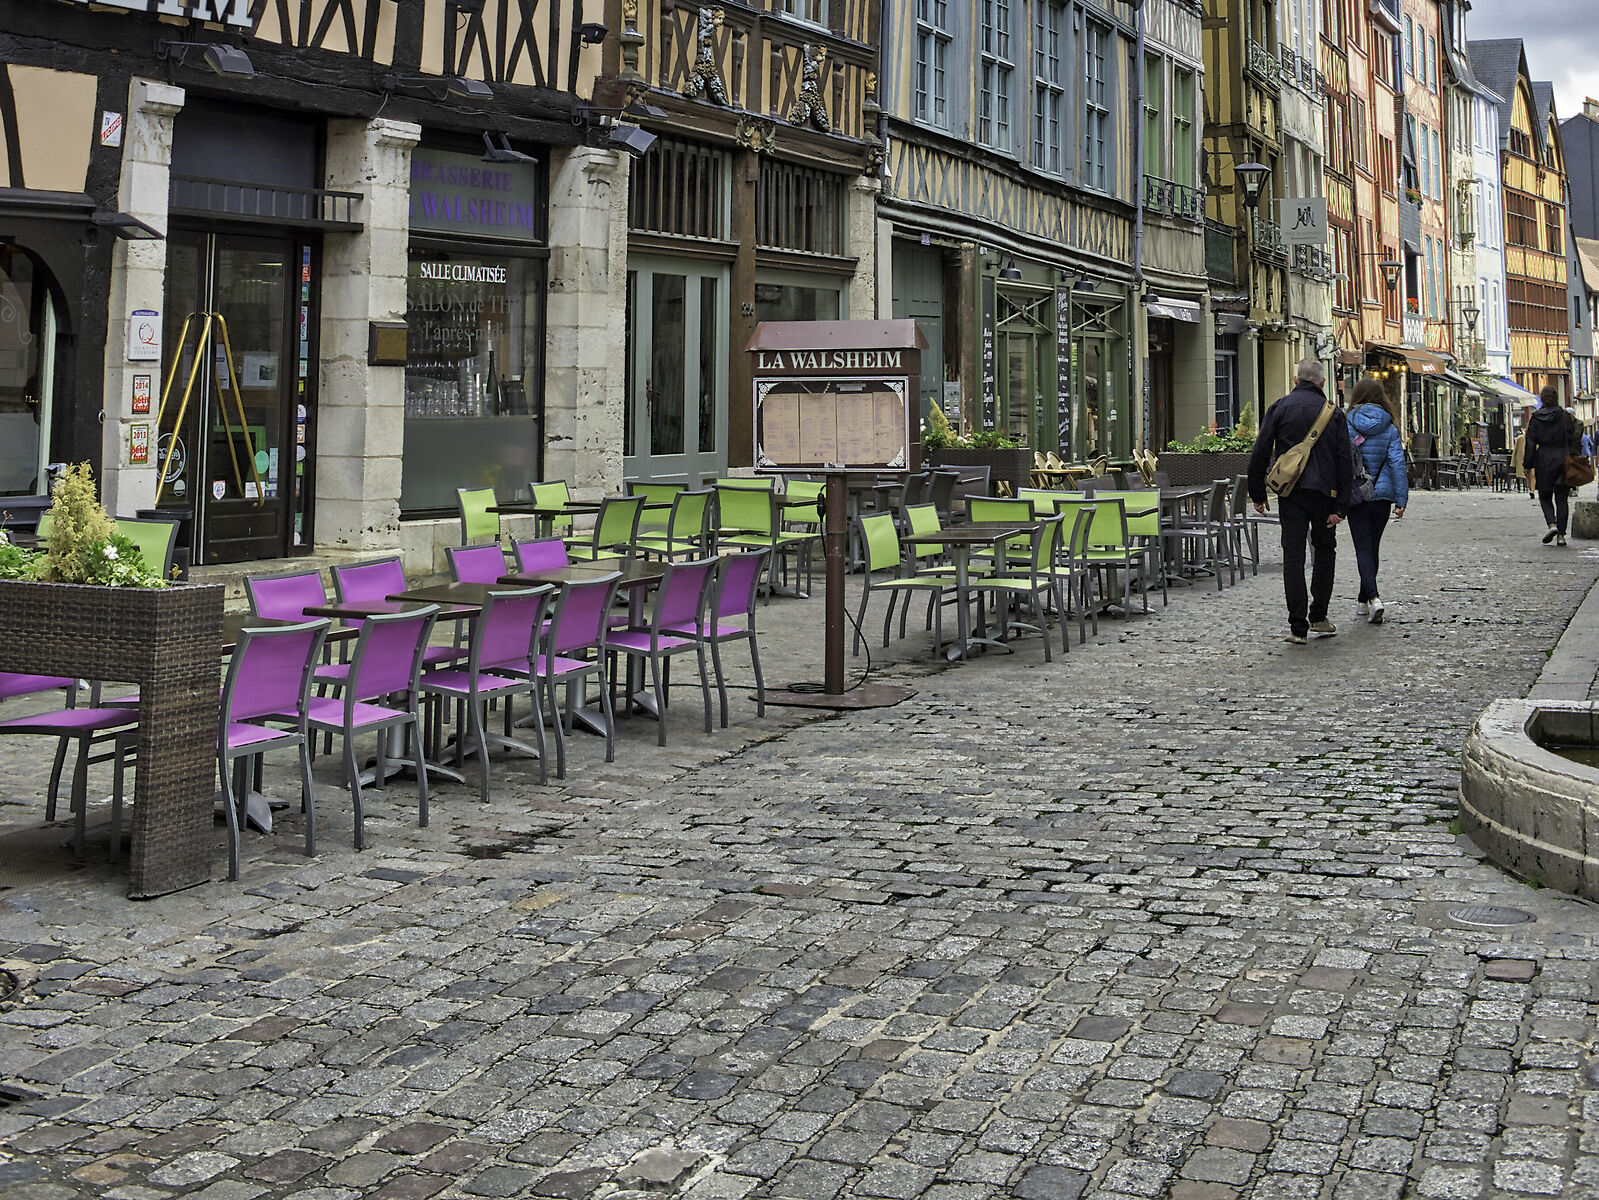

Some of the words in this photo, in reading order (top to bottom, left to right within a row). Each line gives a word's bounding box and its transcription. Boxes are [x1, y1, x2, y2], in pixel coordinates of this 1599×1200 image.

[422, 191, 532, 228] WALSHEIM
[420, 262, 451, 280] SALLE
[452, 265, 507, 283] CLIMATISÉE
[758, 352, 785, 369] LA
[790, 351, 902, 369] WALSHEIM
[135, 382, 149, 390] 2014
[133, 431, 147, 440] 2013
